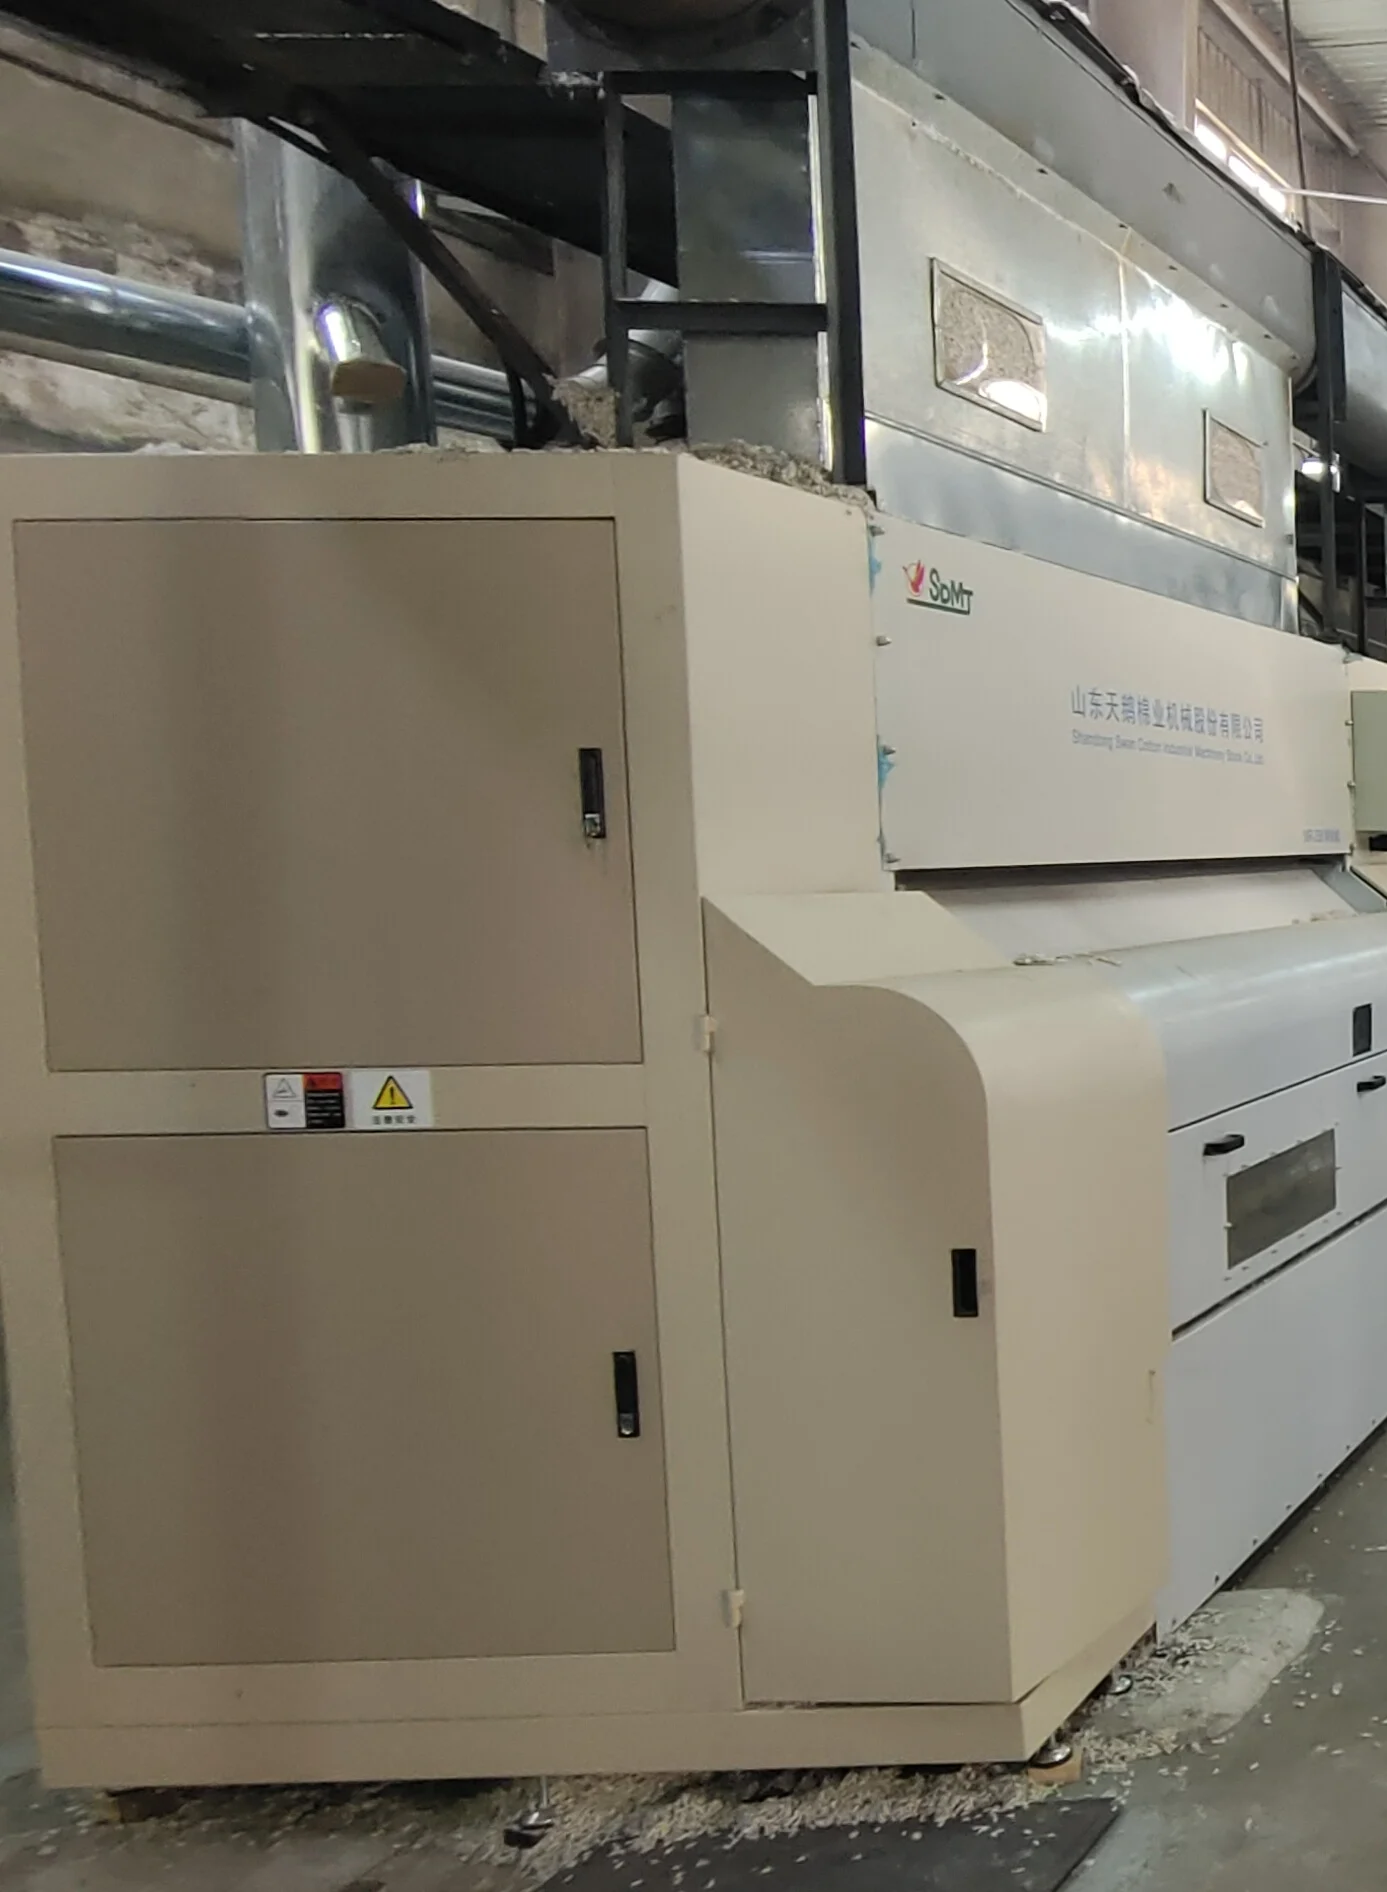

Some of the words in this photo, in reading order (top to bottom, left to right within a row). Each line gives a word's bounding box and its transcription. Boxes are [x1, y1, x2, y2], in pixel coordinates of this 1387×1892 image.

[1070, 684, 1264, 744] 山东天鹅棉业机械股份有限公司
